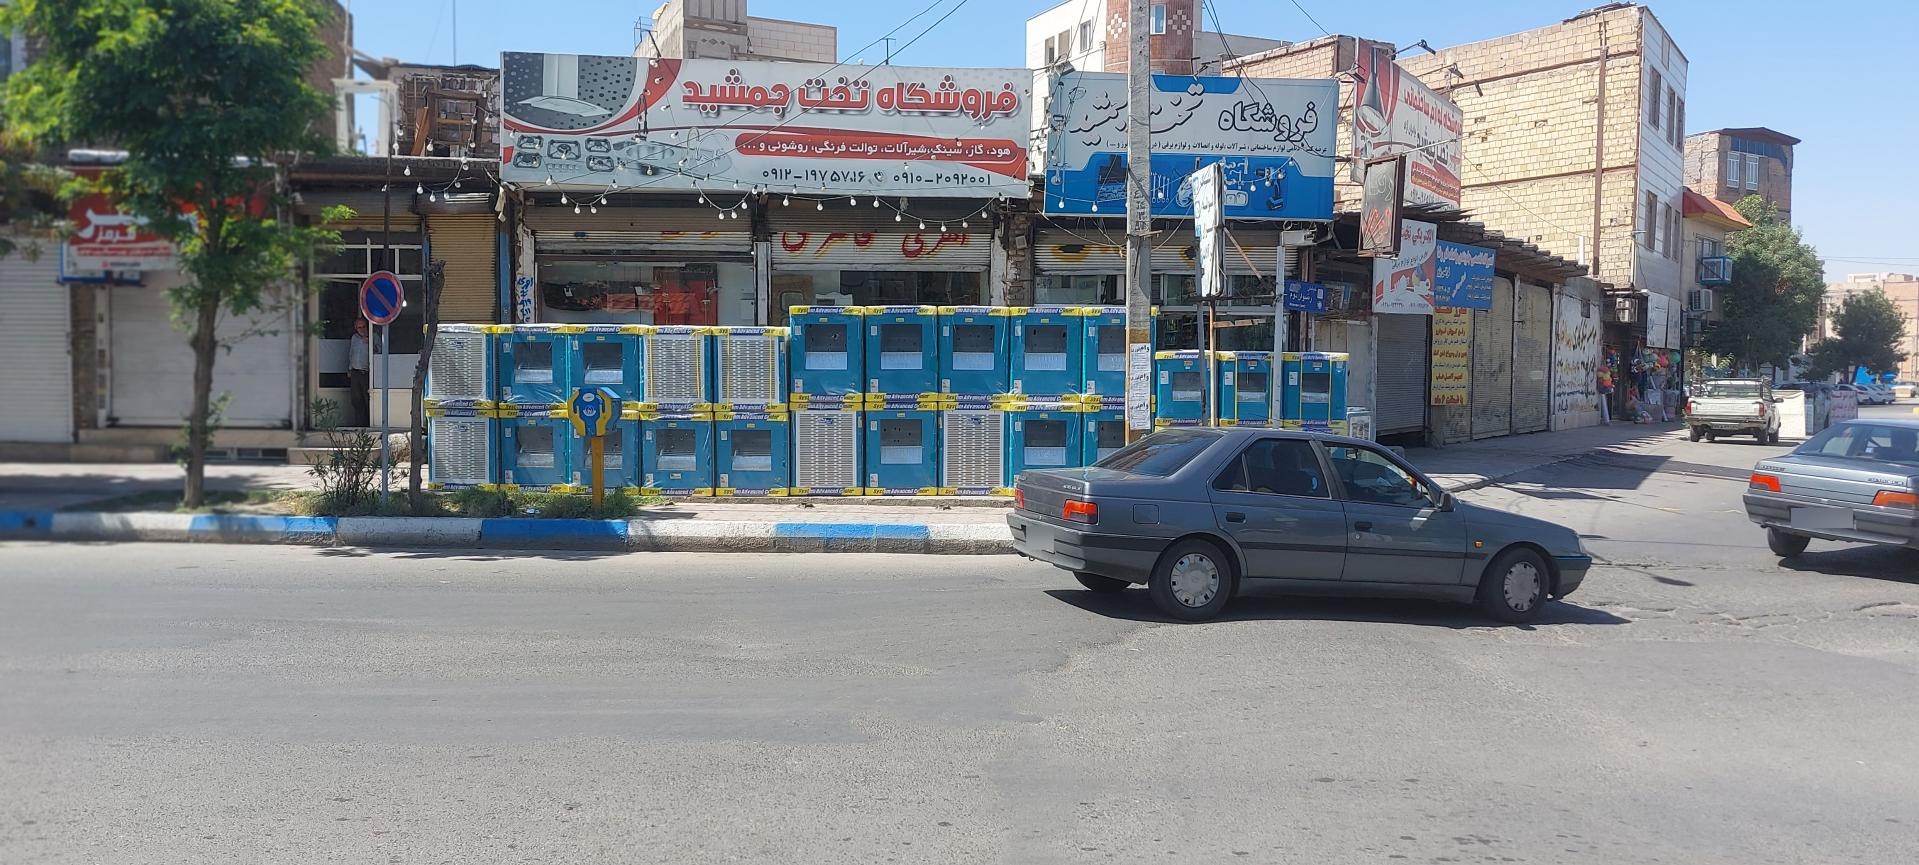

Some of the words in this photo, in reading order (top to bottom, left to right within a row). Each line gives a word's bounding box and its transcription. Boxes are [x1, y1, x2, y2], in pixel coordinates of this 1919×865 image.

[682, 68, 791, 115] جمشید
[797, 77, 870, 111] تخت
[877, 74, 1019, 121] فروشگاه
[1218, 101, 1318, 143] فروشگاه
[759, 142, 766, 151] و
[849, 142, 878, 155] توالت
[965, 144, 985, 157] گاز،
[987, 144, 1011, 157] هود،
[893, 171, 992, 187] ۰۹۱۰-۲۰۹۲۰۰۱
